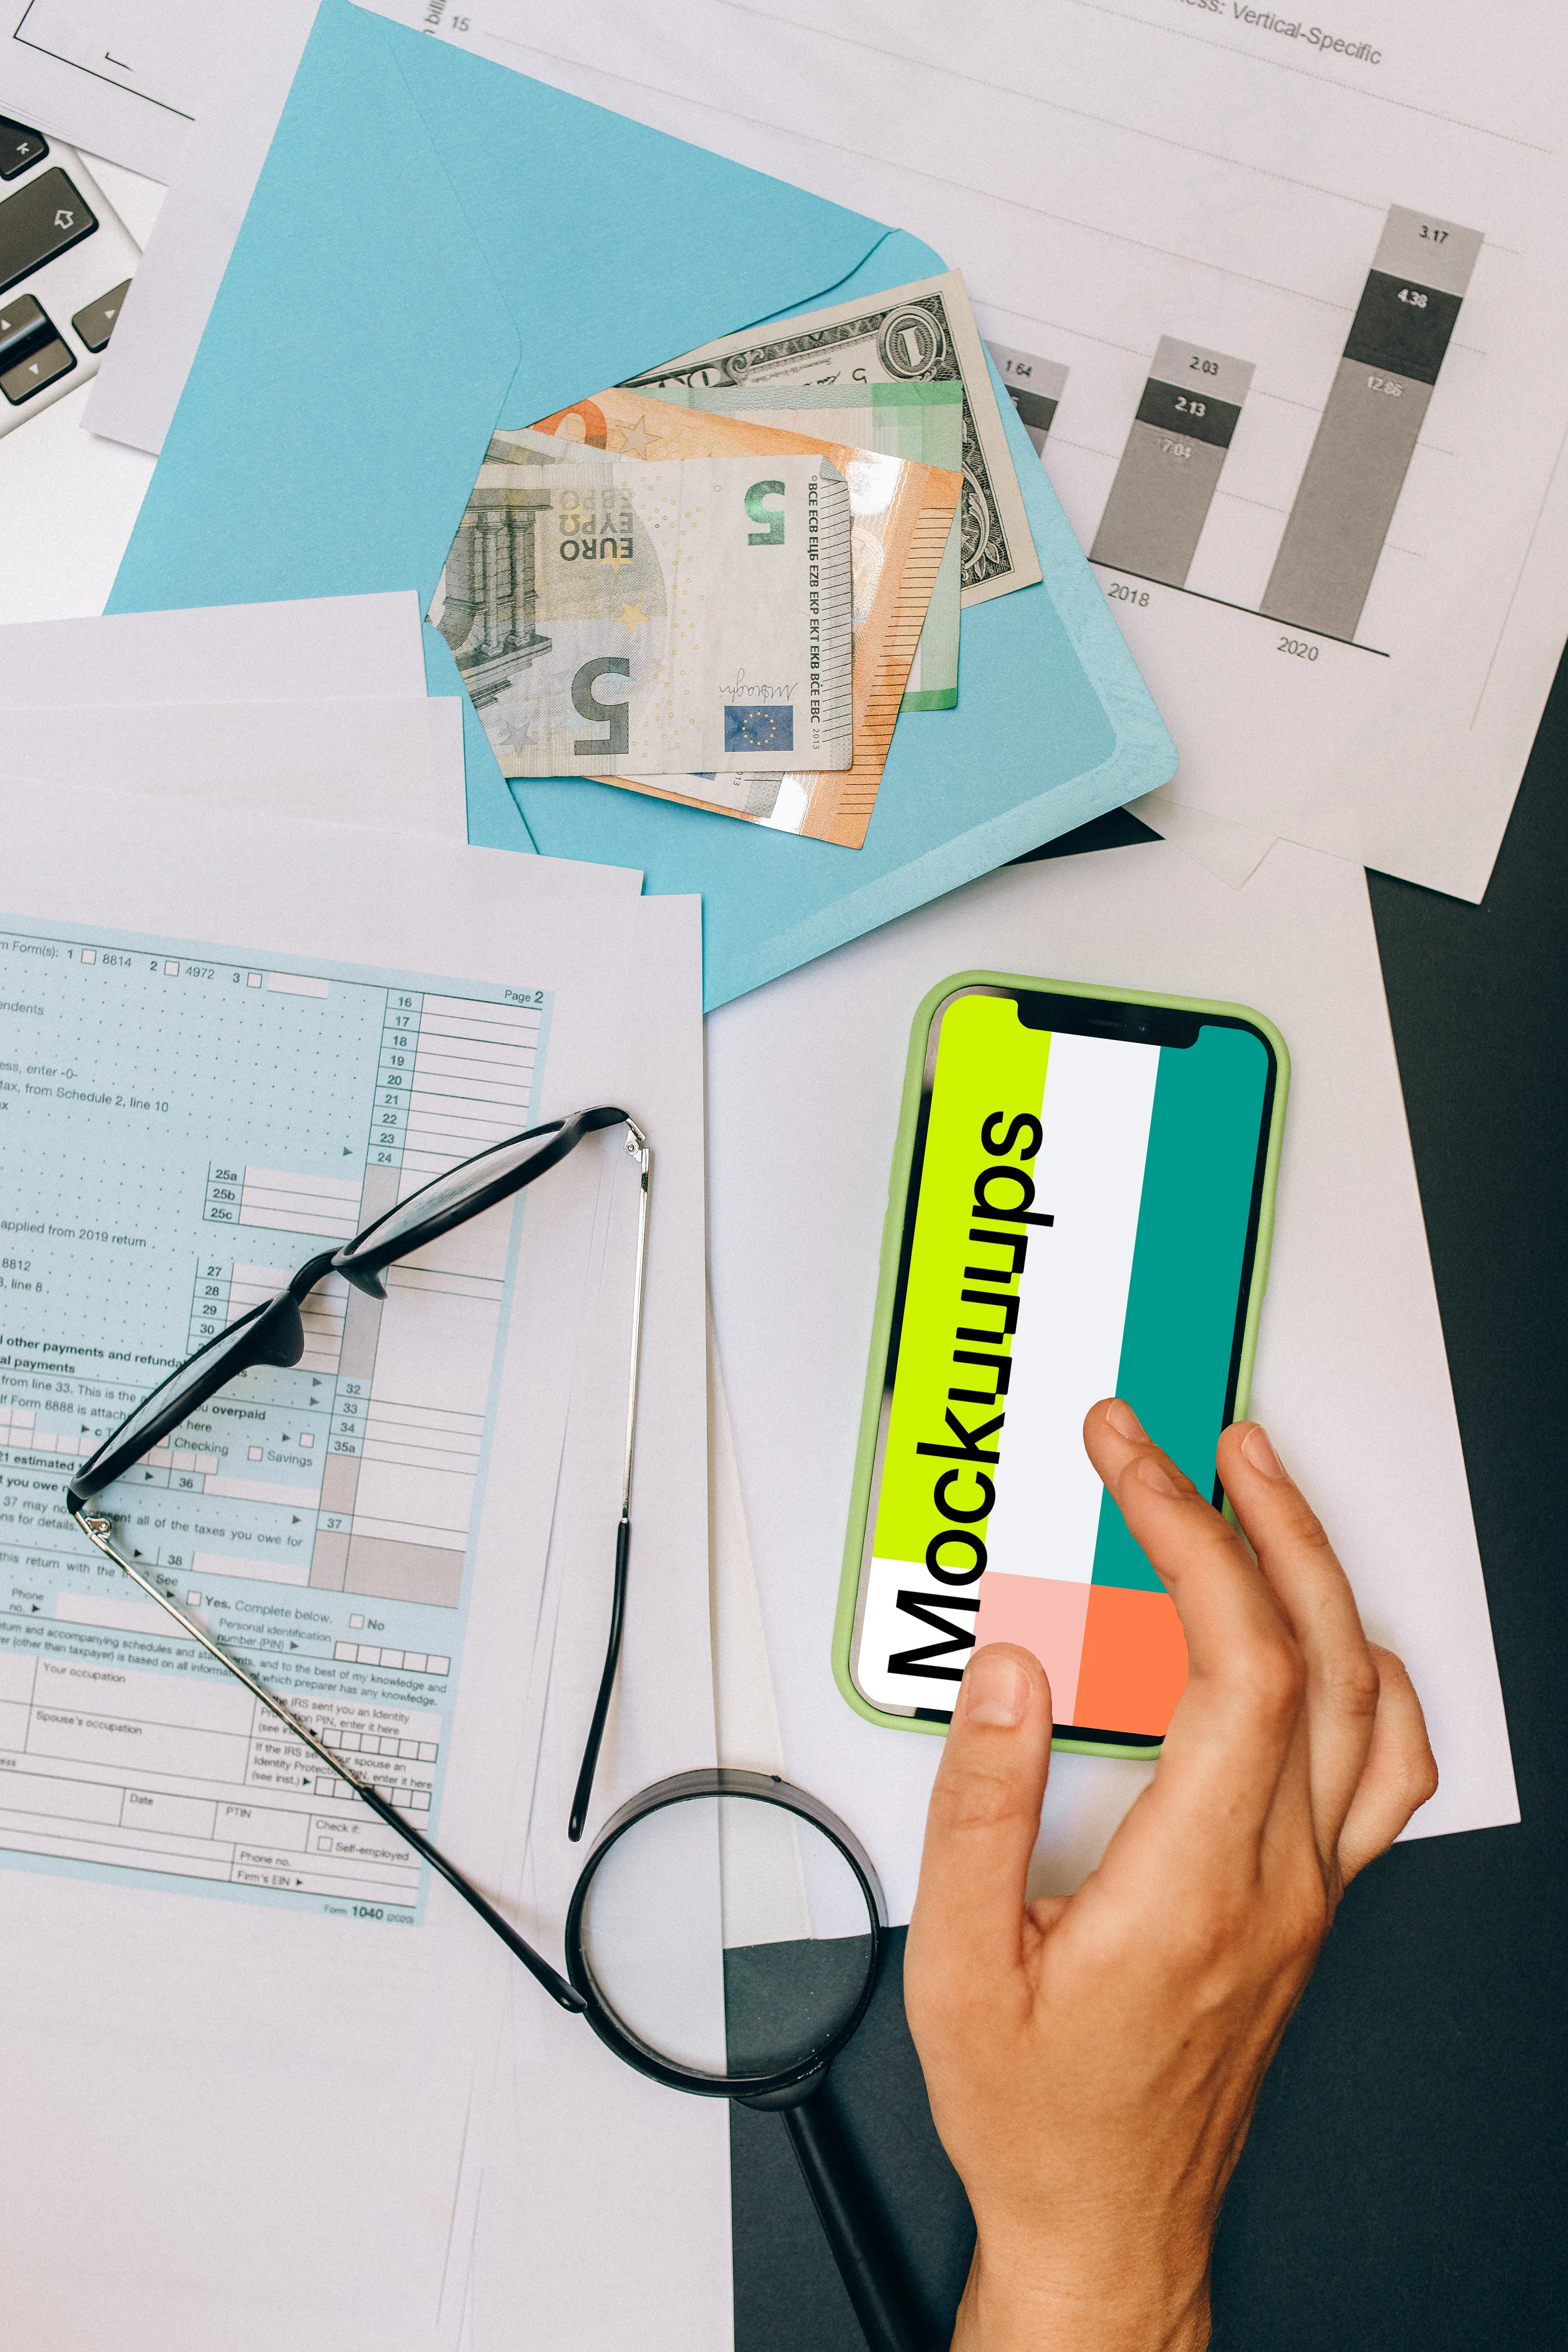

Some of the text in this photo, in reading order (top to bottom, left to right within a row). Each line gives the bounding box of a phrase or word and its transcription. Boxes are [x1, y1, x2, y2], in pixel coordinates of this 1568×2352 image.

[452, 16, 471, 32] 15
[1233, 2, 1382, 64] Vertical-Specific
[1419, 225, 1449, 244] 3.17
[1190, 355, 1218, 376] 2.03
[744, 480, 785, 546] 5
[809, 510, 818, 533] ECB
[560, 537, 633, 561] EURO
[809, 565, 819, 588] EZB
[809, 591, 819, 615] EKP
[1108, 581, 1150, 608] 2018
[810, 619, 820, 643] EKT
[810, 645, 820, 670] EKB
[1277, 636, 1319, 662] 2020
[572, 657, 629, 756] 5
[811, 699, 820, 723] EBC
[13, 941, 58, 959] Form(s):
[67, 949, 73, 959] 1
[103, 954, 132, 967] 8814
[150, 961, 158, 971] 2
[185, 966, 215, 979] 4972
[232, 973, 240, 983] 3
[399, 997, 412, 1008] 16
[504, 990, 544, 1003] Page 2
[396, 1016, 410, 1026] 17
[394, 1035, 407, 1047] 18
[27, 1065, 57, 1076] enter
[391, 1055, 405, 1066] 19
[388, 1074, 402, 1085] 20
[25, 1083, 169, 1112] from Schedule 2, line 10
[385, 1094, 398, 1105] 21
[382, 1113, 397, 1124] 22
[380, 1133, 394, 1144] 23
[378, 1152, 391, 1163] 24
[215, 1169, 237, 1181] 25a
[213, 1188, 235, 1200] 25b
[211, 1208, 232, 1220] 25c
[1, 1219, 147, 1247] applied from 2019 return
[2, 1257, 31, 1271] 8812
[207, 1266, 222, 1277] 27
[11, 1278, 32, 1291] line
[35, 1282, 42, 1292] 8
[205, 1286, 219, 1296] 28
[203, 1304, 217, 1315] 29
[200, 1324, 215, 1335] 30
[7, 1337, 40, 1349] other
[43, 1342, 104, 1358] payments
[109, 1349, 131, 1363] and
[14, 1358, 75, 1373] payments
[2, 1375, 29, 1389] from
[32, 1380, 52, 1391] line
[56, 1383, 73, 1395] 33.
[79, 1385, 102, 1398] This
[105, 1390, 114, 1398] is
[119, 1391, 136, 1403] the
[346, 1384, 360, 1394] 32
[888, 1112, 1054, 1682] Mockuuups
[11, 1396, 265, 1421] Form 8888 is overpaid
[343, 1403, 357, 1414] 33
[341, 1422, 354, 1432] 34
[175, 1419, 313, 1468] here Checking Savings
[334, 1441, 355, 1453] 35a
[14, 1455, 74, 1470] estimated
[179, 1478, 193, 1488] 36
[7, 1478, 29, 1487] you
[33, 1481, 58, 1491] owe
[327, 1518, 342, 1528] 37
[23, 1500, 48, 1513] may
[137, 1514, 151, 1525] all
[171, 1519, 189, 1532] the
[194, 1524, 225, 1537] taxes
[231, 1530, 252, 1542] you
[258, 1534, 282, 1544] owe
[287, 1535, 303, 1547] for
[38, 1517, 77, 1532] details.
[168, 1555, 182, 1565] 38
[26, 1556, 60, 1570] return
[67, 1562, 90, 1574] with
[97, 1565, 115, 1577] the
[156, 1573, 178, 1586] See
[11, 1587, 385, 1631] Phone Yes. Complete below. No
[219, 1618, 331, 1641] Personal identification
[216, 1632, 286, 1650] number (PIN)
[25, 1625, 44, 1636] and
[48, 1628, 119, 1649] accompanying
[122, 1639, 172, 1655] schedules
[176, 1648, 195, 1660] and
[260, 1660, 279, 1670] and
[295, 1663, 310, 1673] the
[314, 1666, 336, 1678] best
[371, 1673, 424, 1691] knowledge
[427, 1681, 447, 1694] and
[43, 1662, 126, 1684] Your occupation
[44, 1642, 438, 1707] than taxpayer) based which preparer has any knowledge.
[291, 1698, 410, 1724] IRS sent you Identity
[36, 1710, 142, 1735] Spouse's occupation
[340, 1718, 400, 1736] enter here
[265, 1743, 281, 1754] the
[284, 1746, 302, 1757] IRS
[354, 1755, 391, 1772] spouse
[253, 1756, 291, 1771] Identity
[373, 1772, 400, 1786] enter
[410, 1776, 432, 1789] here
[130, 1793, 348, 1834] Date PTIN Check
[239, 1850, 271, 1866] Phone
[335, 1841, 410, 1862] Self-employed
[272, 1875, 291, 1887] EIN
[352, 1904, 384, 1920] 1040
